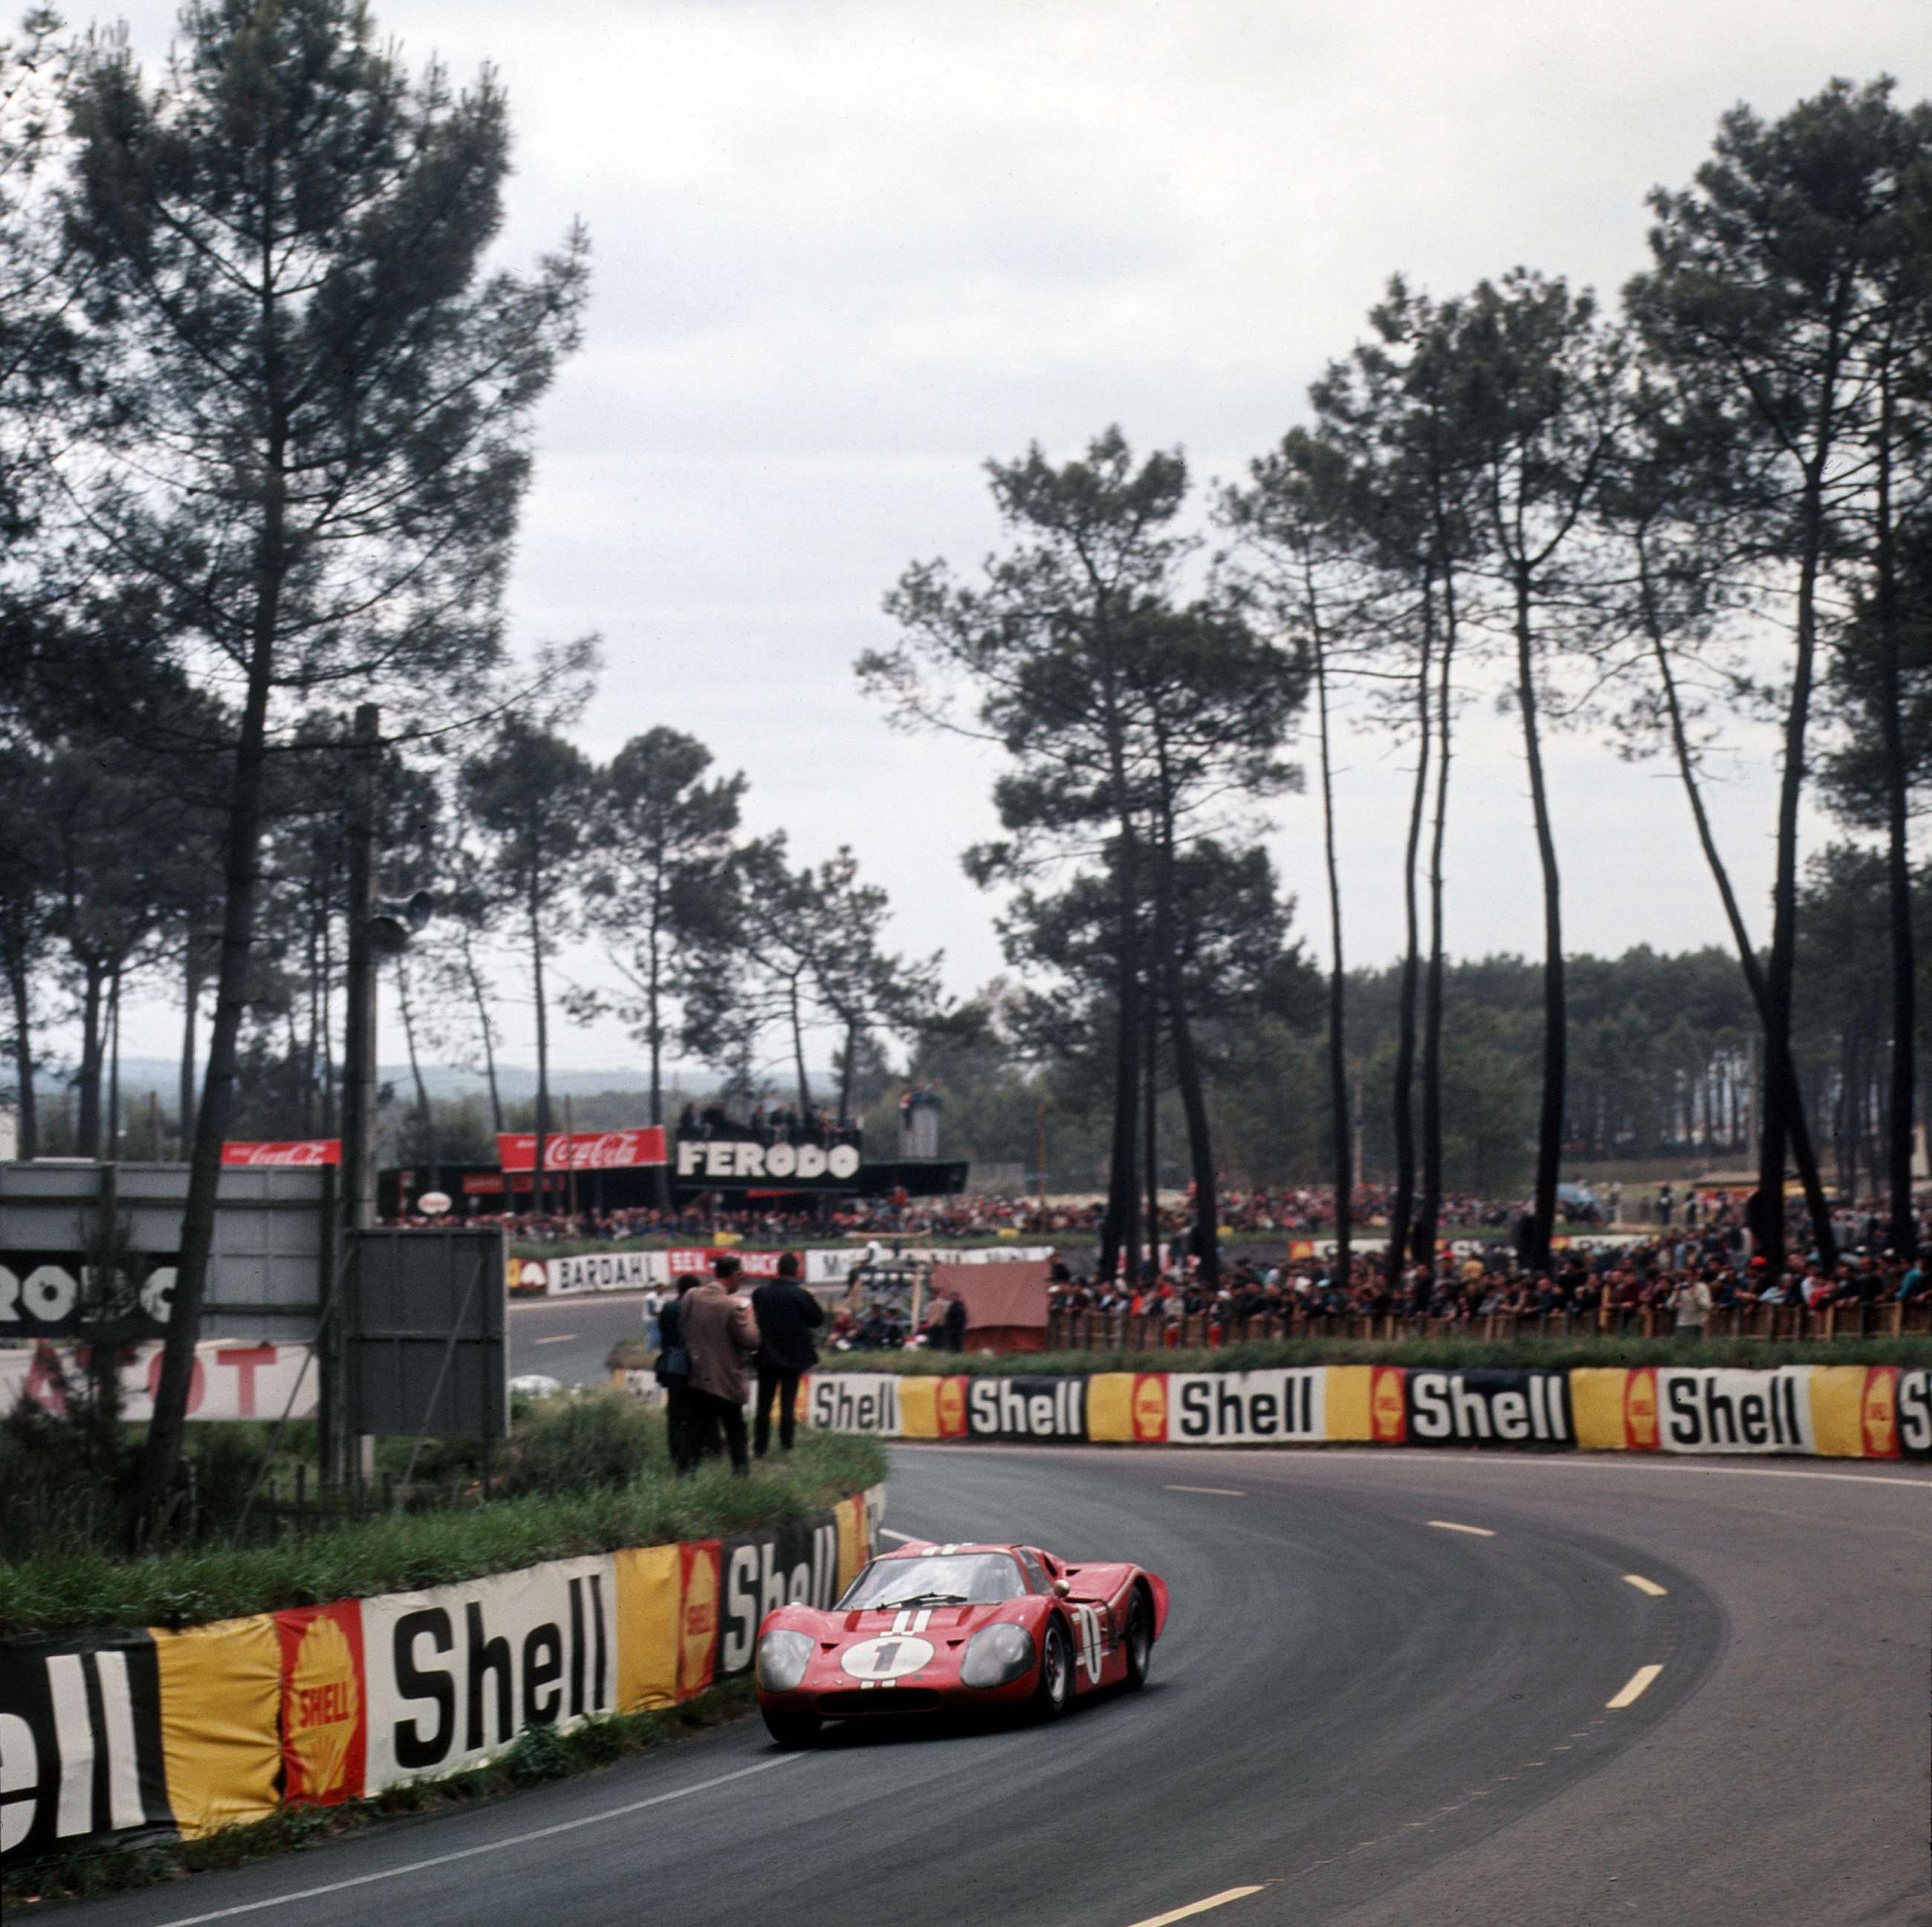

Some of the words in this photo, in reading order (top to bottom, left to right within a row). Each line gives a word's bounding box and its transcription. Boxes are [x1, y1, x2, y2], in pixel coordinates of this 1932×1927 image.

[677, 1140, 860, 1178] FERODO
[559, 1256, 658, 1289] BARDAHL
[815, 1382, 895, 1429] Shell
[971, 1378, 1083, 1435] Shell
[1181, 1376, 1312, 1437] Shell
[1413, 1373, 1569, 1439] Shell
[1667, 1376, 1802, 1445] Shell
[723, 1525, 834, 1671] Shell
[393, 1574, 607, 1769] Shell
[873, 1642, 903, 1671] 1
[299, 1680, 349, 1729] SHELL
